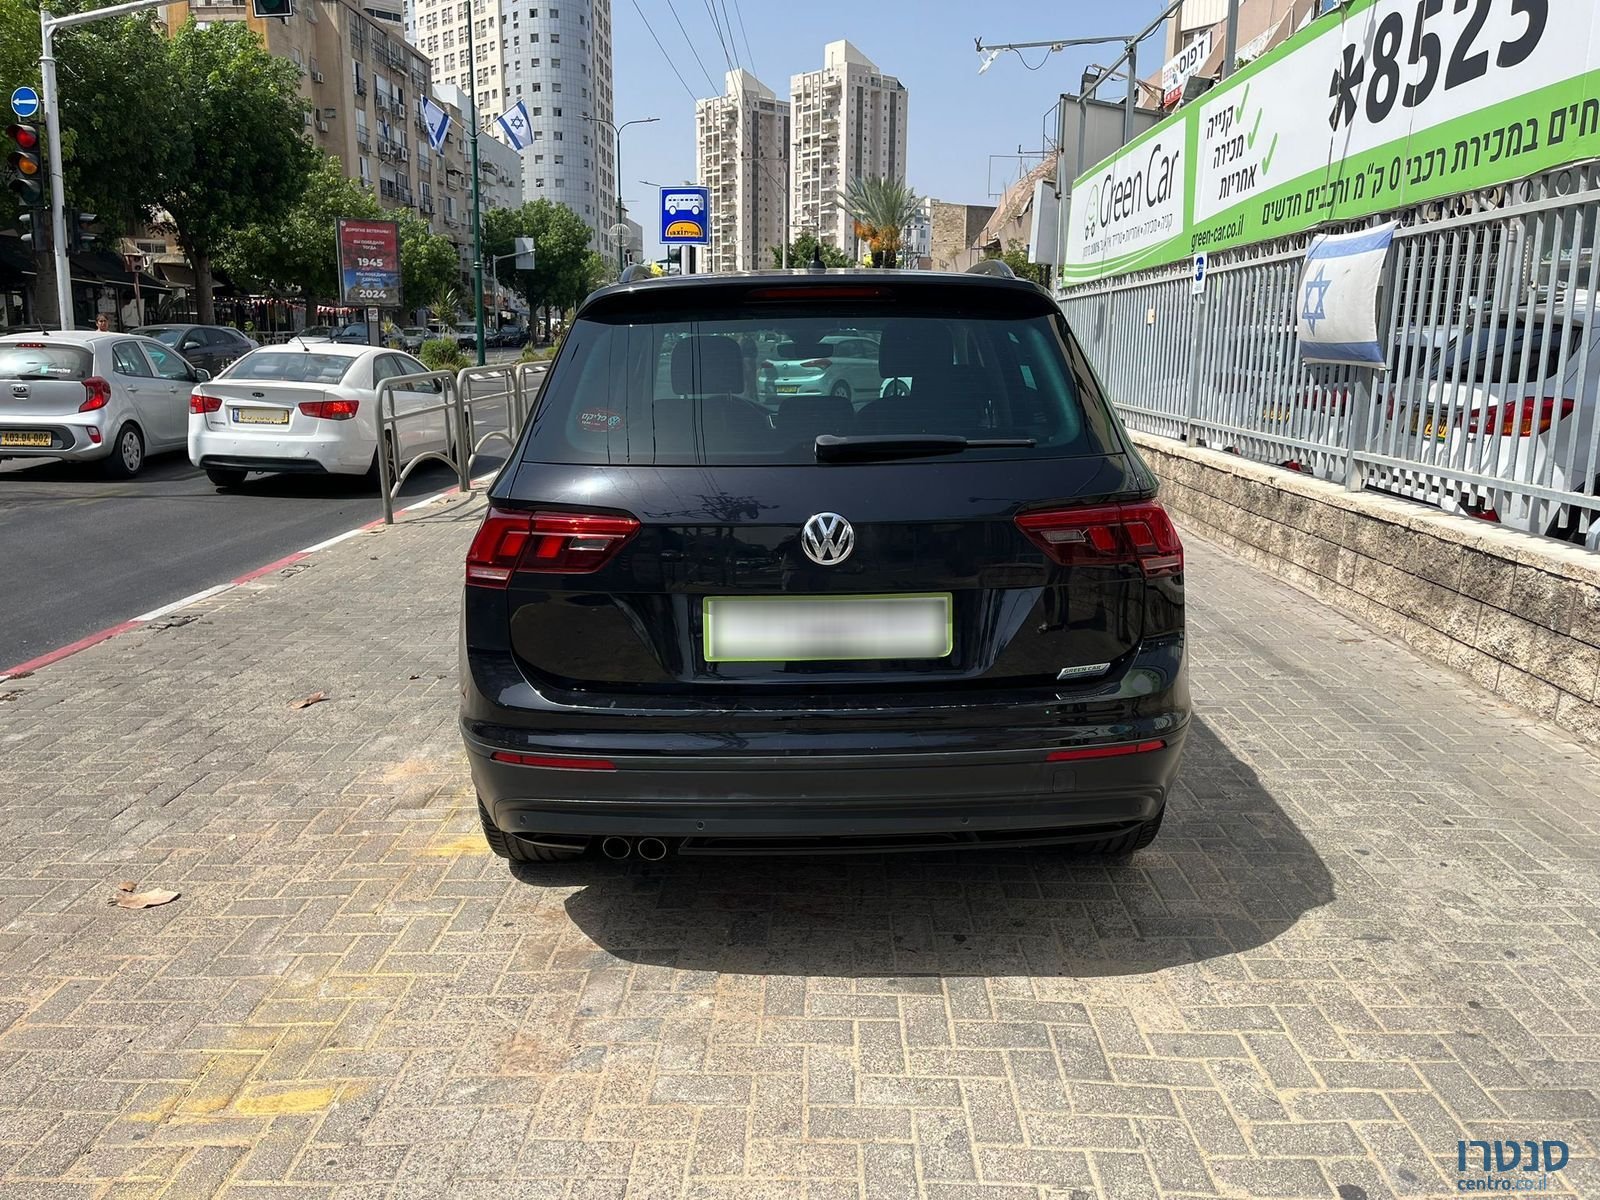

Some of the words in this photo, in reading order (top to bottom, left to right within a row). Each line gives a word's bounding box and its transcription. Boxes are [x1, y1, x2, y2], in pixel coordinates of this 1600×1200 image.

[1180, 40, 1205, 74] דפוס
[1206, 105, 1234, 139] קנייה
[1212, 134, 1244, 170] מכירה
[1450, 117, 1539, 174] במכירת
[1218, 163, 1258, 200] אחריות
[1406, 147, 1447, 186] רכבי
[1100, 170, 1142, 228] Green
[1146, 143, 1180, 207] Car
[1304, 177, 1350, 214] ורכבים
[1261, 193, 1303, 226] חדשים
[1191, 213, 1245, 252] green-car.co.il
[357, 257, 383, 267] 1945
[359, 289, 387, 298] 2024
